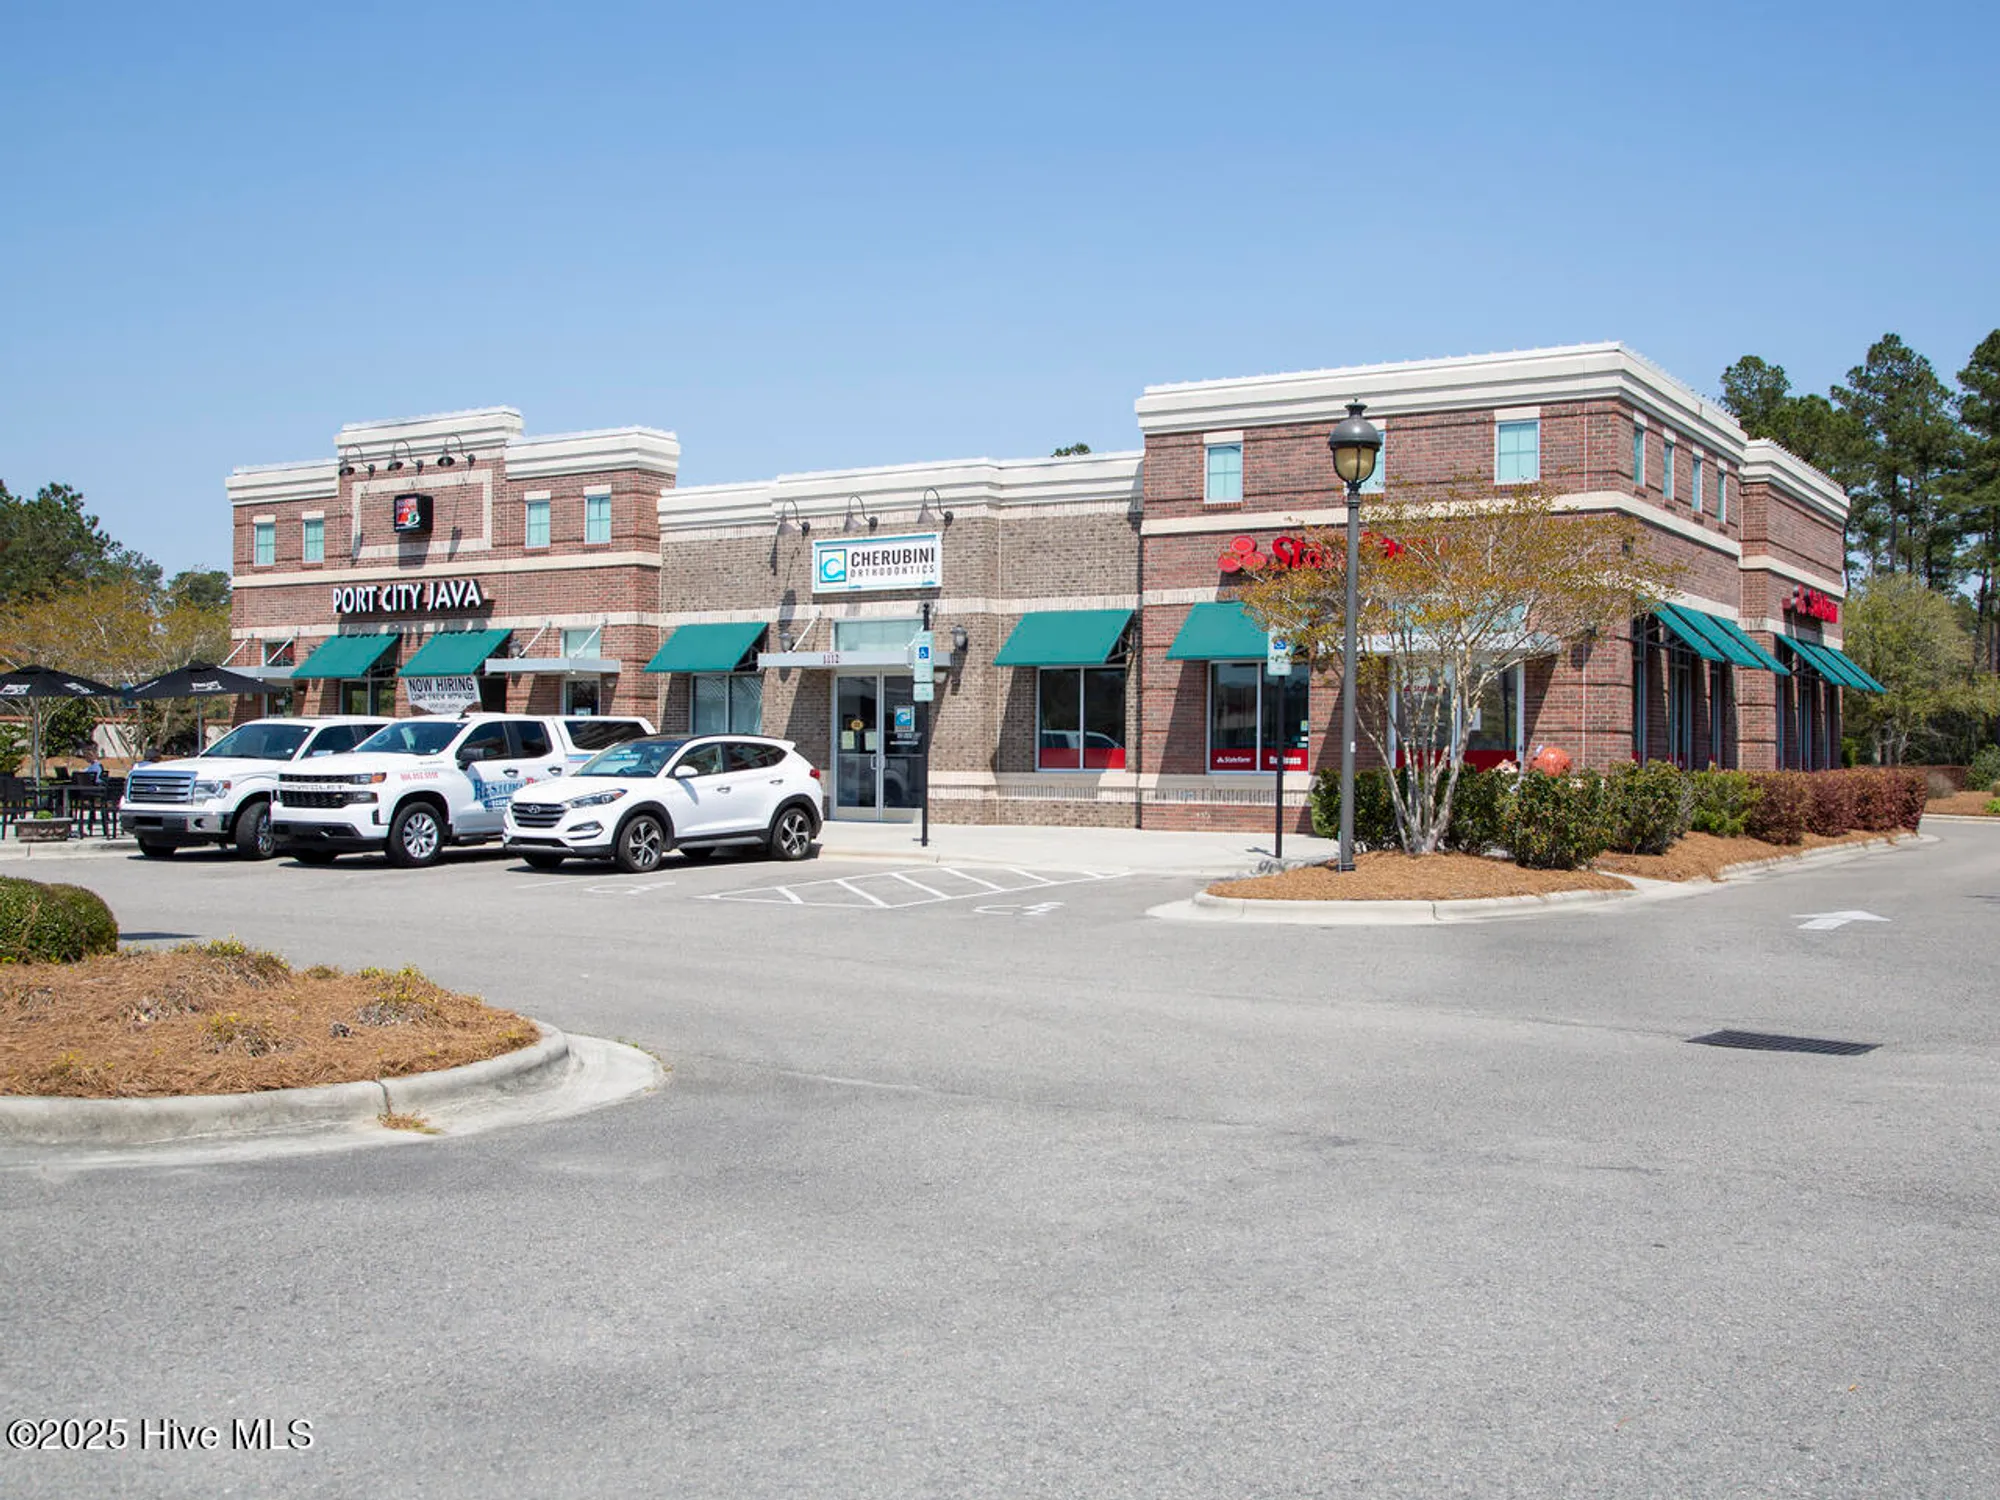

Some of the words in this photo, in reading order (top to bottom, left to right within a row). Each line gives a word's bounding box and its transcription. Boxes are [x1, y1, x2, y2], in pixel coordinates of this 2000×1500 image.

[851, 547, 935, 568] CHERUBINI
[850, 564, 935, 578] ORTHODONTICS
[332, 586, 378, 614] PORT
[381, 583, 422, 612] CITY
[427, 579, 481, 612] JAVA
[408, 678, 433, 692] NOW
[436, 677, 475, 692] HIRING
